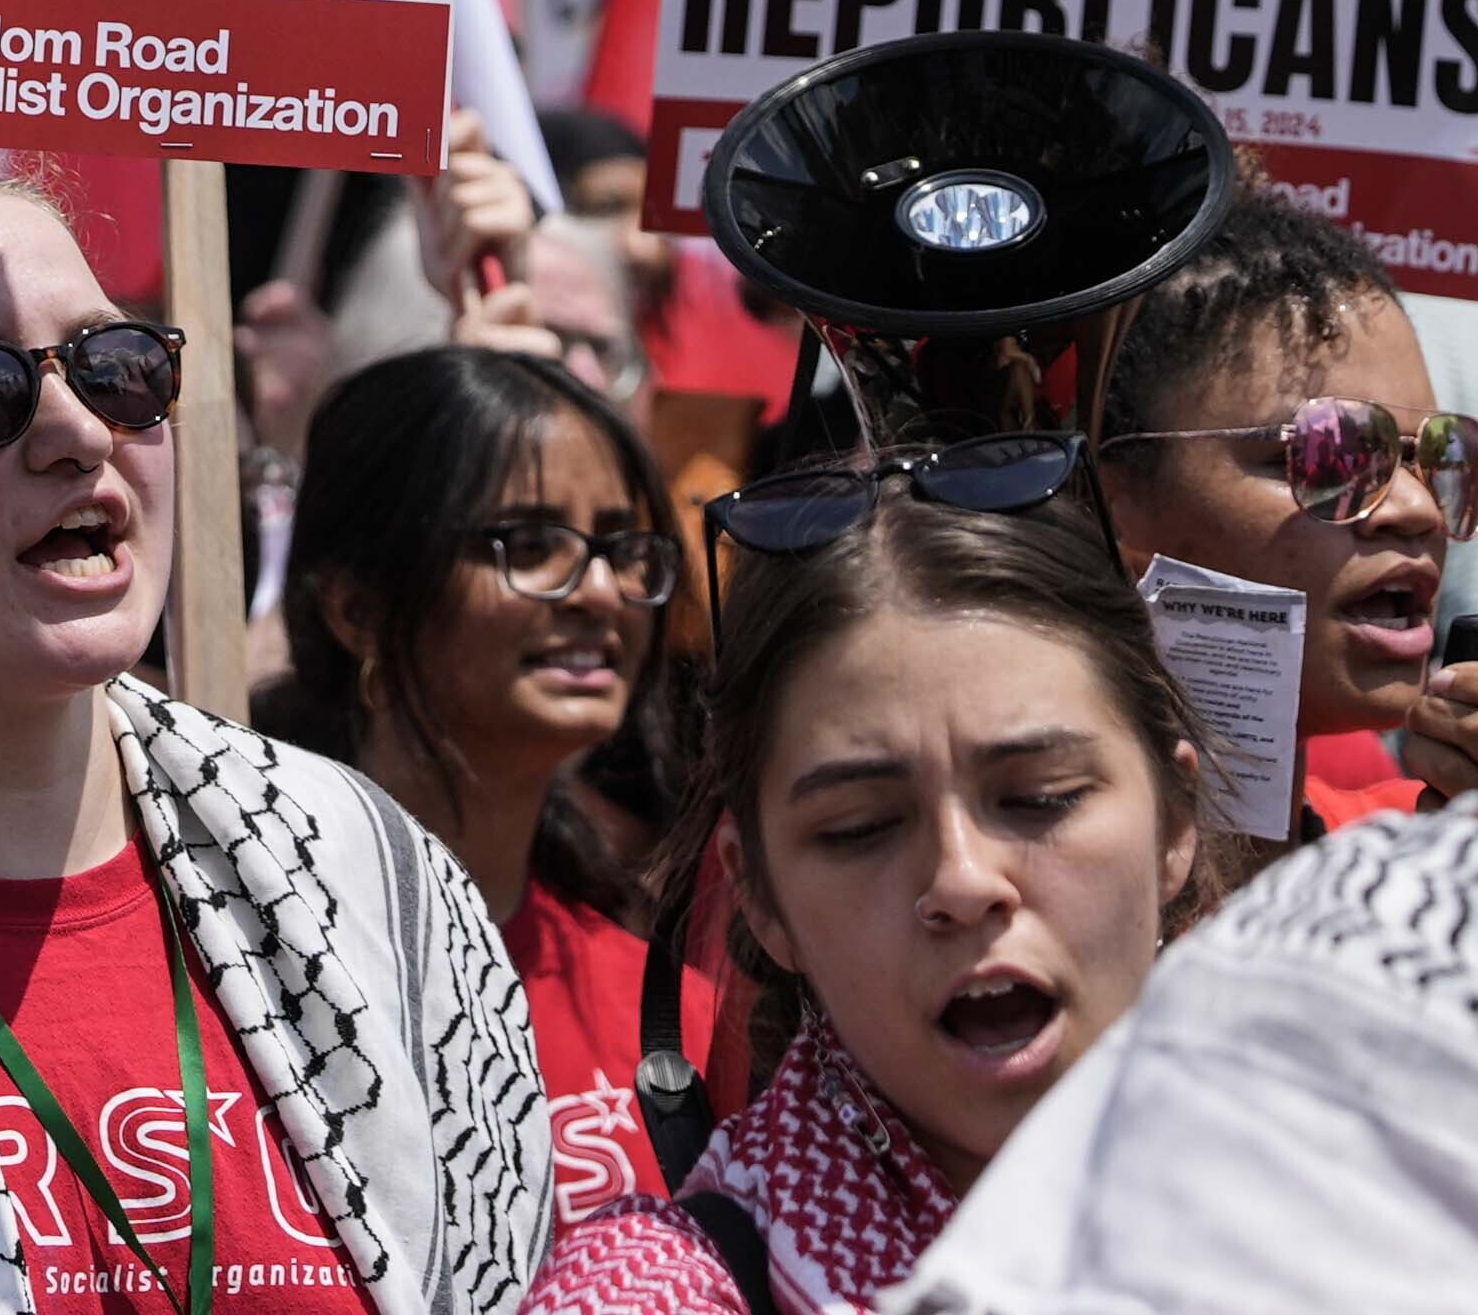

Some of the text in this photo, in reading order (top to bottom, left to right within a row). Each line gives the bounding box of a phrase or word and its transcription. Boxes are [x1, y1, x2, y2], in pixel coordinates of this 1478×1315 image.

[94, 19, 231, 75] Road
[76, 72, 400, 139] Organization
[1162, 600, 1288, 624] WHY WE'RE HERE
[45, 1257, 357, 1296] Socialist rganizati
